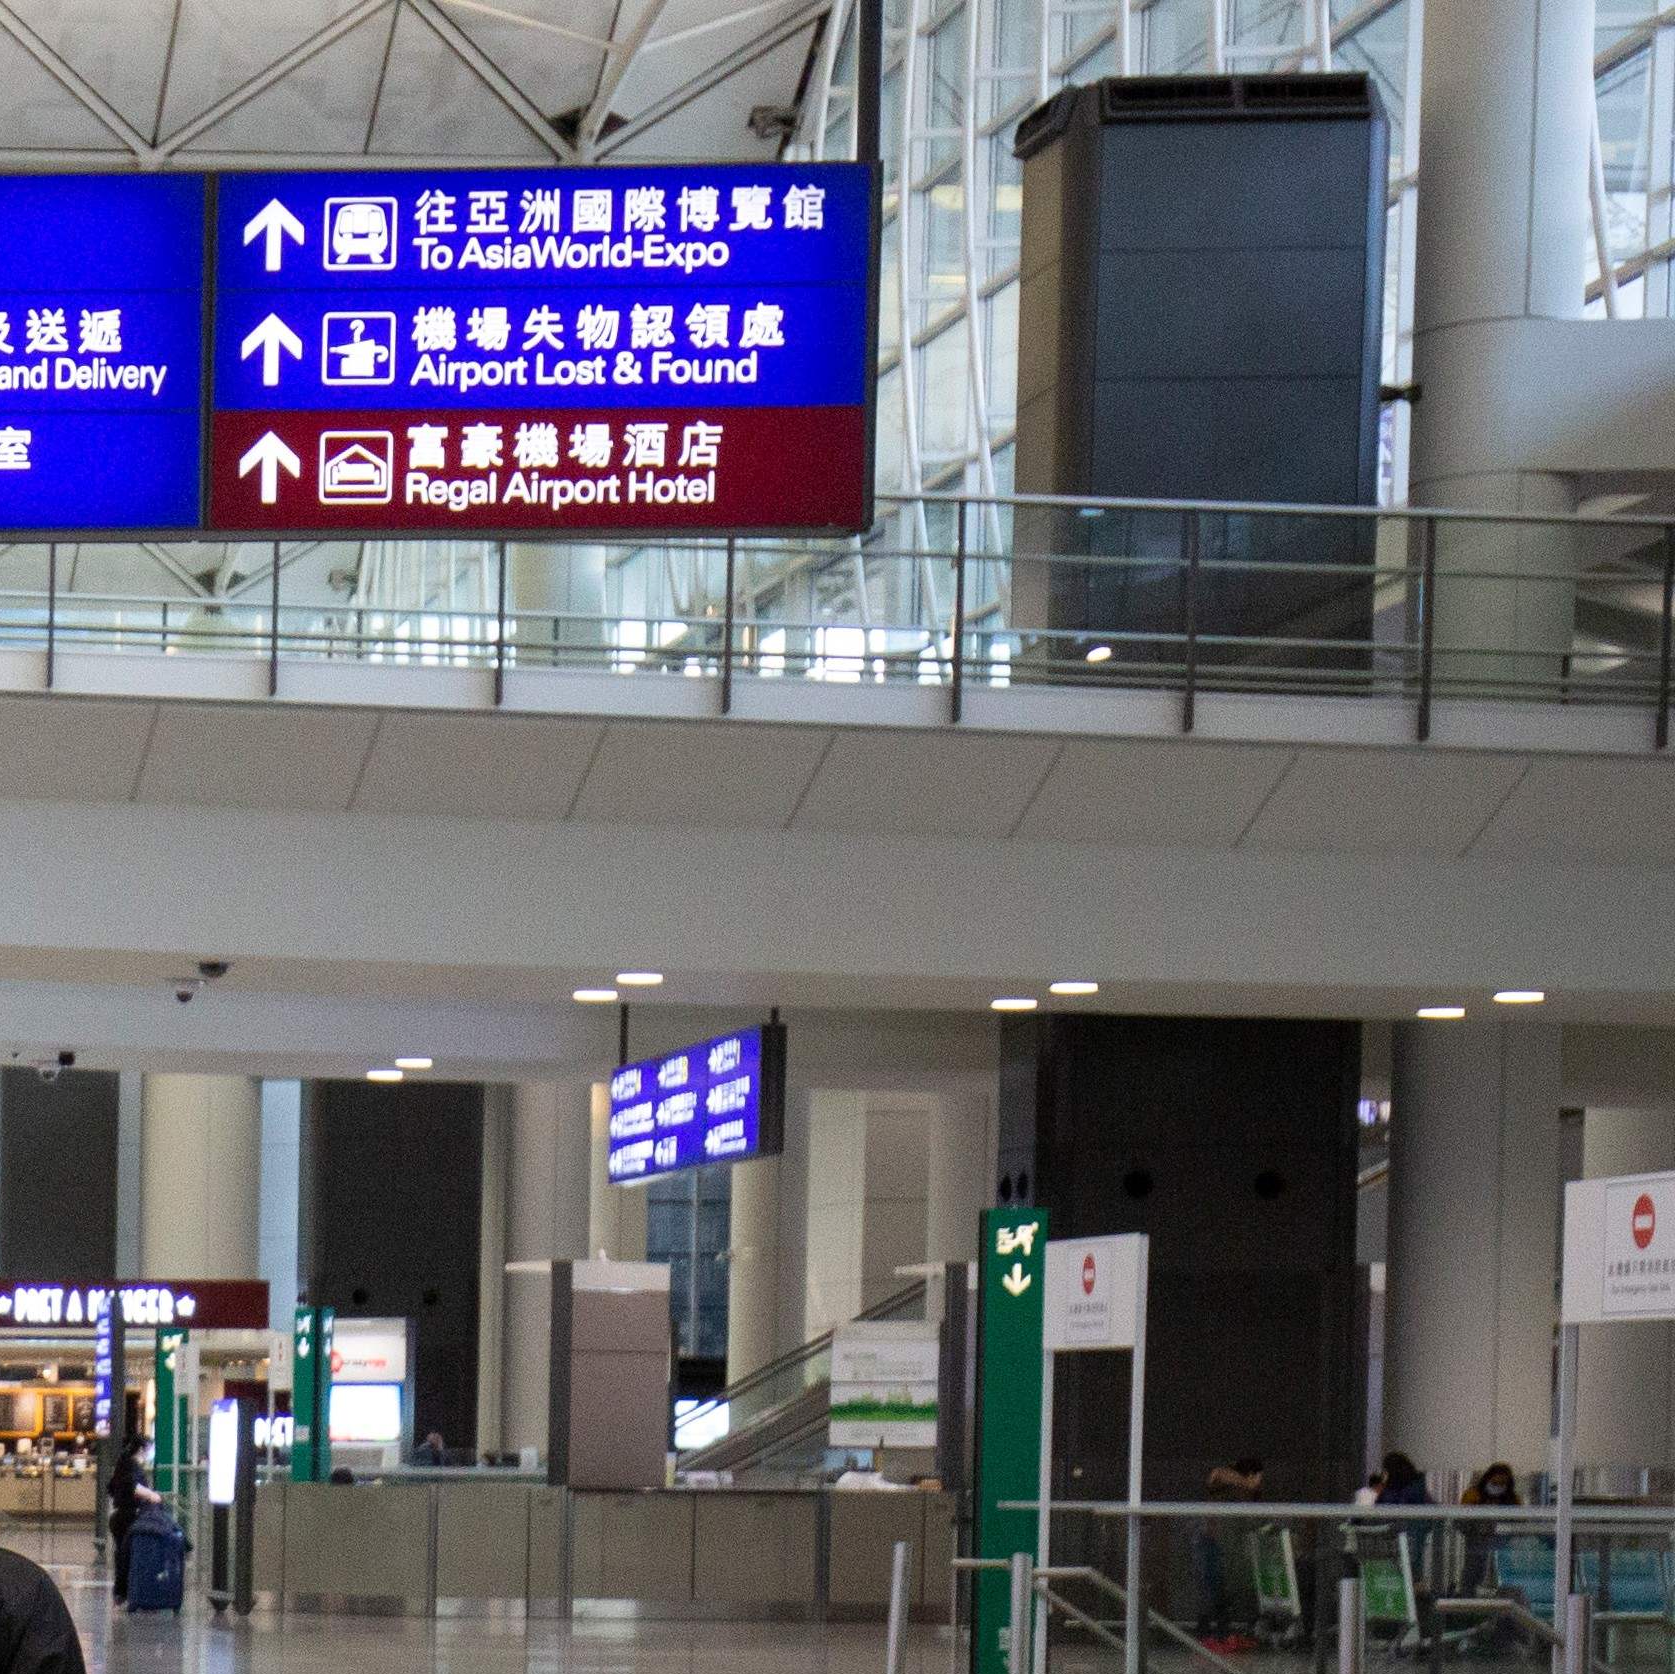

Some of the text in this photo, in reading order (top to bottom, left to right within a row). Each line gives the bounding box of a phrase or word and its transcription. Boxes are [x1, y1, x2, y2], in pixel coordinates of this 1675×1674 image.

[414, 184, 825, 233] 往亞洲國際博覽館
[413, 237, 729, 273] To AsiaWorld-Expo
[412, 302, 784, 351] 機場失物認領處
[55, 358, 167, 395] Delivery
[410, 351, 757, 392] Airport Lost & Found
[407, 421, 723, 469] 富豪機場酒店
[406, 471, 715, 511] Regal Airport Hotel
[66, 1288, 84, 1323] A
